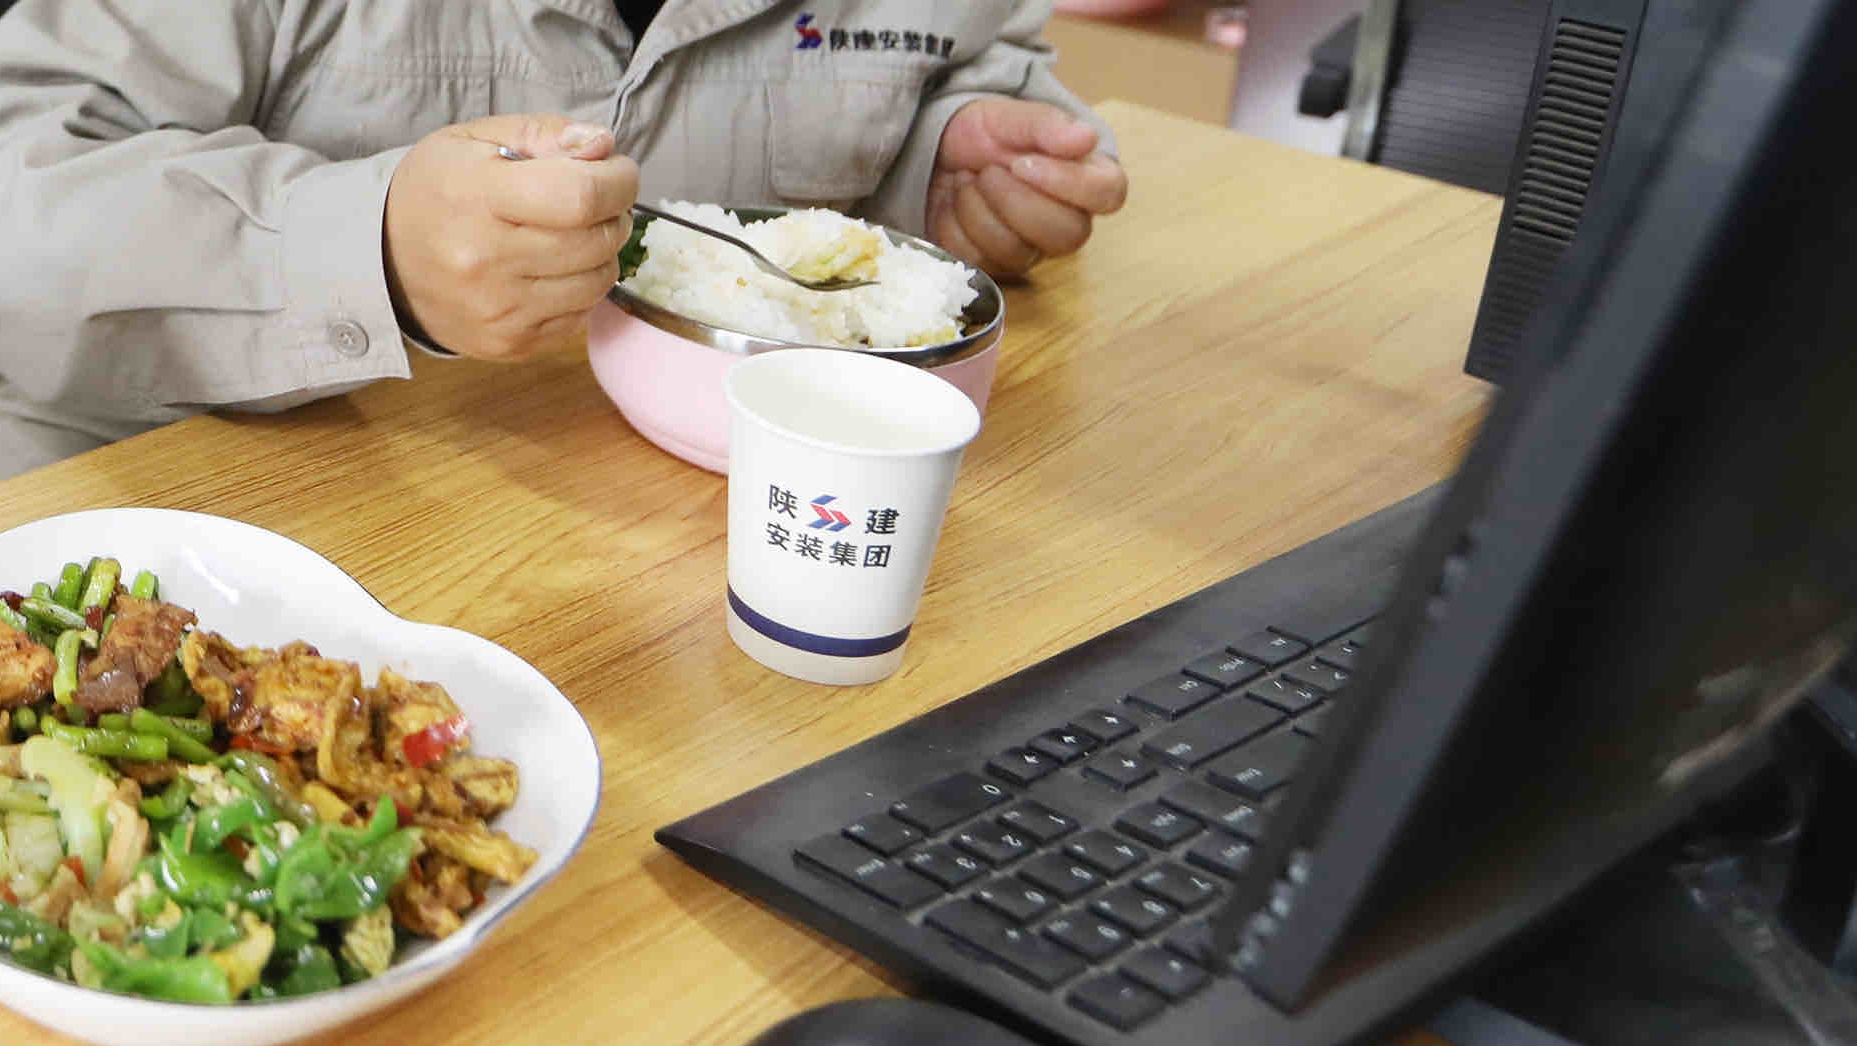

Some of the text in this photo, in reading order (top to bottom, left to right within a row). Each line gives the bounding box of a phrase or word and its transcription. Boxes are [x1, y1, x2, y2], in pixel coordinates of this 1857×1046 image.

[768, 484, 900, 535] 陕 建
[767, 521, 892, 568] 安装集团
